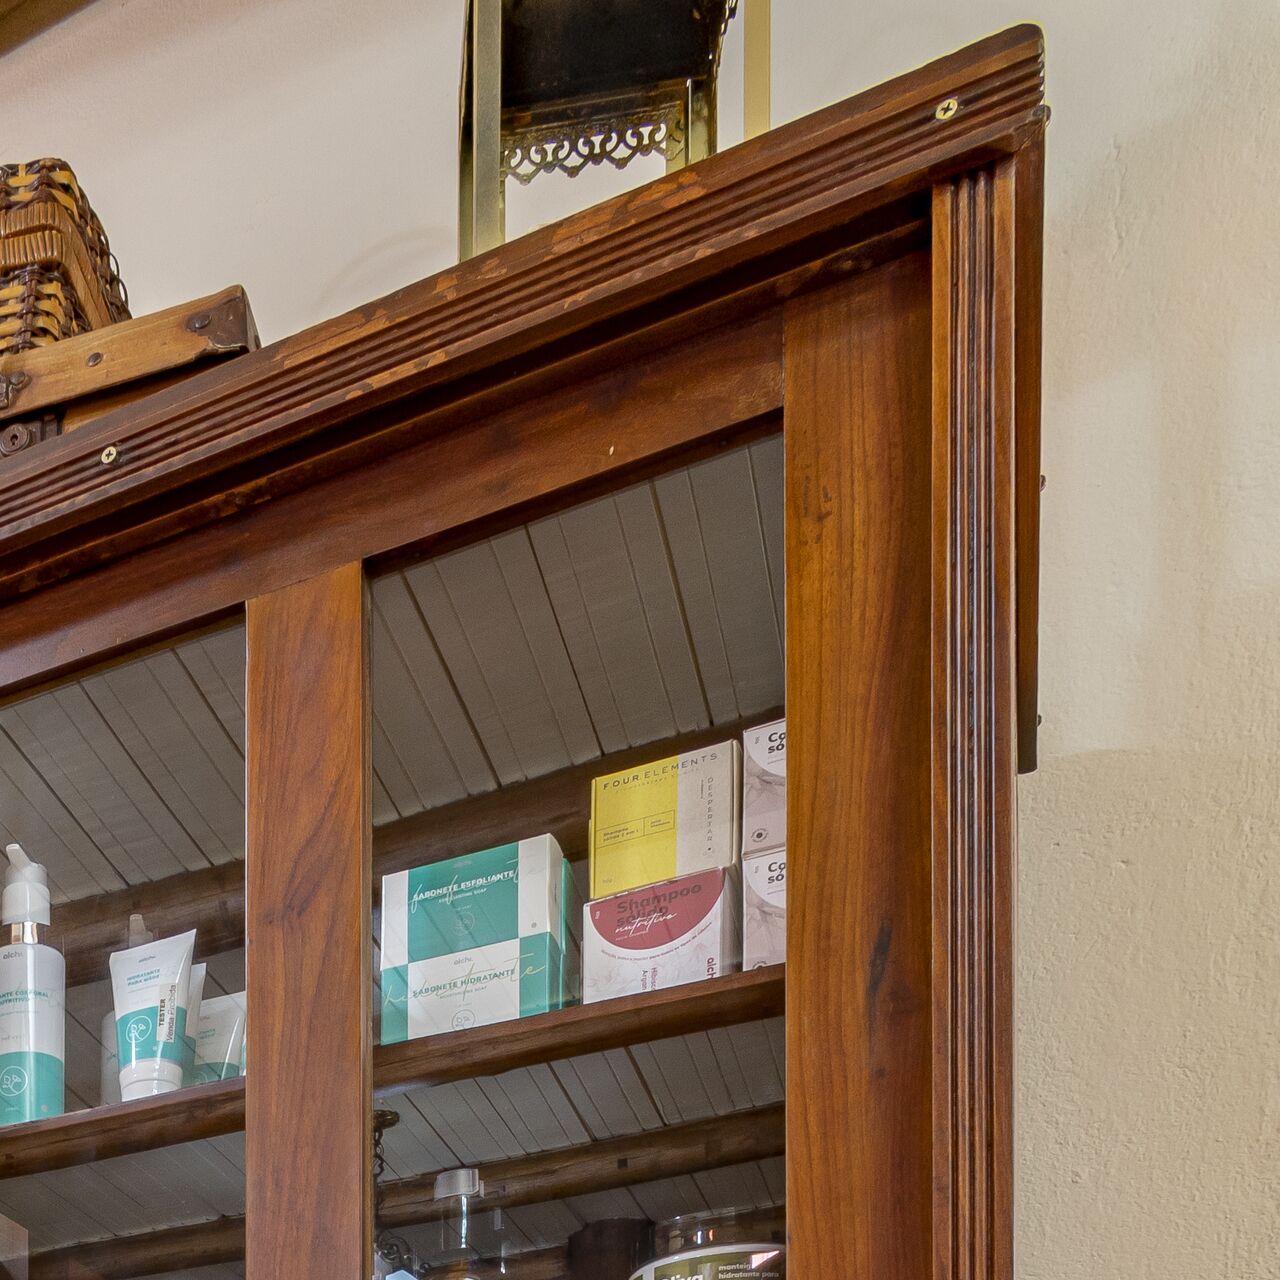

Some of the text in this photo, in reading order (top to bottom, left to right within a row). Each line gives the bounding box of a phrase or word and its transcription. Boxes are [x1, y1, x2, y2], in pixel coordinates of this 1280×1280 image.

[644, 753, 718, 778] ELEMENTS
[413, 871, 515, 901] SABONETE ESFOLIANTE
[616, 883, 703, 915] Shampoo
[412, 968, 516, 998] SABONETE HIDRATANTE
[158, 998, 166, 1028] TESTER
[166, 1017, 176, 1041] Venda
[718, 1263, 753, 1272] manteig
[718, 1271, 780, 1280] hidratante para
